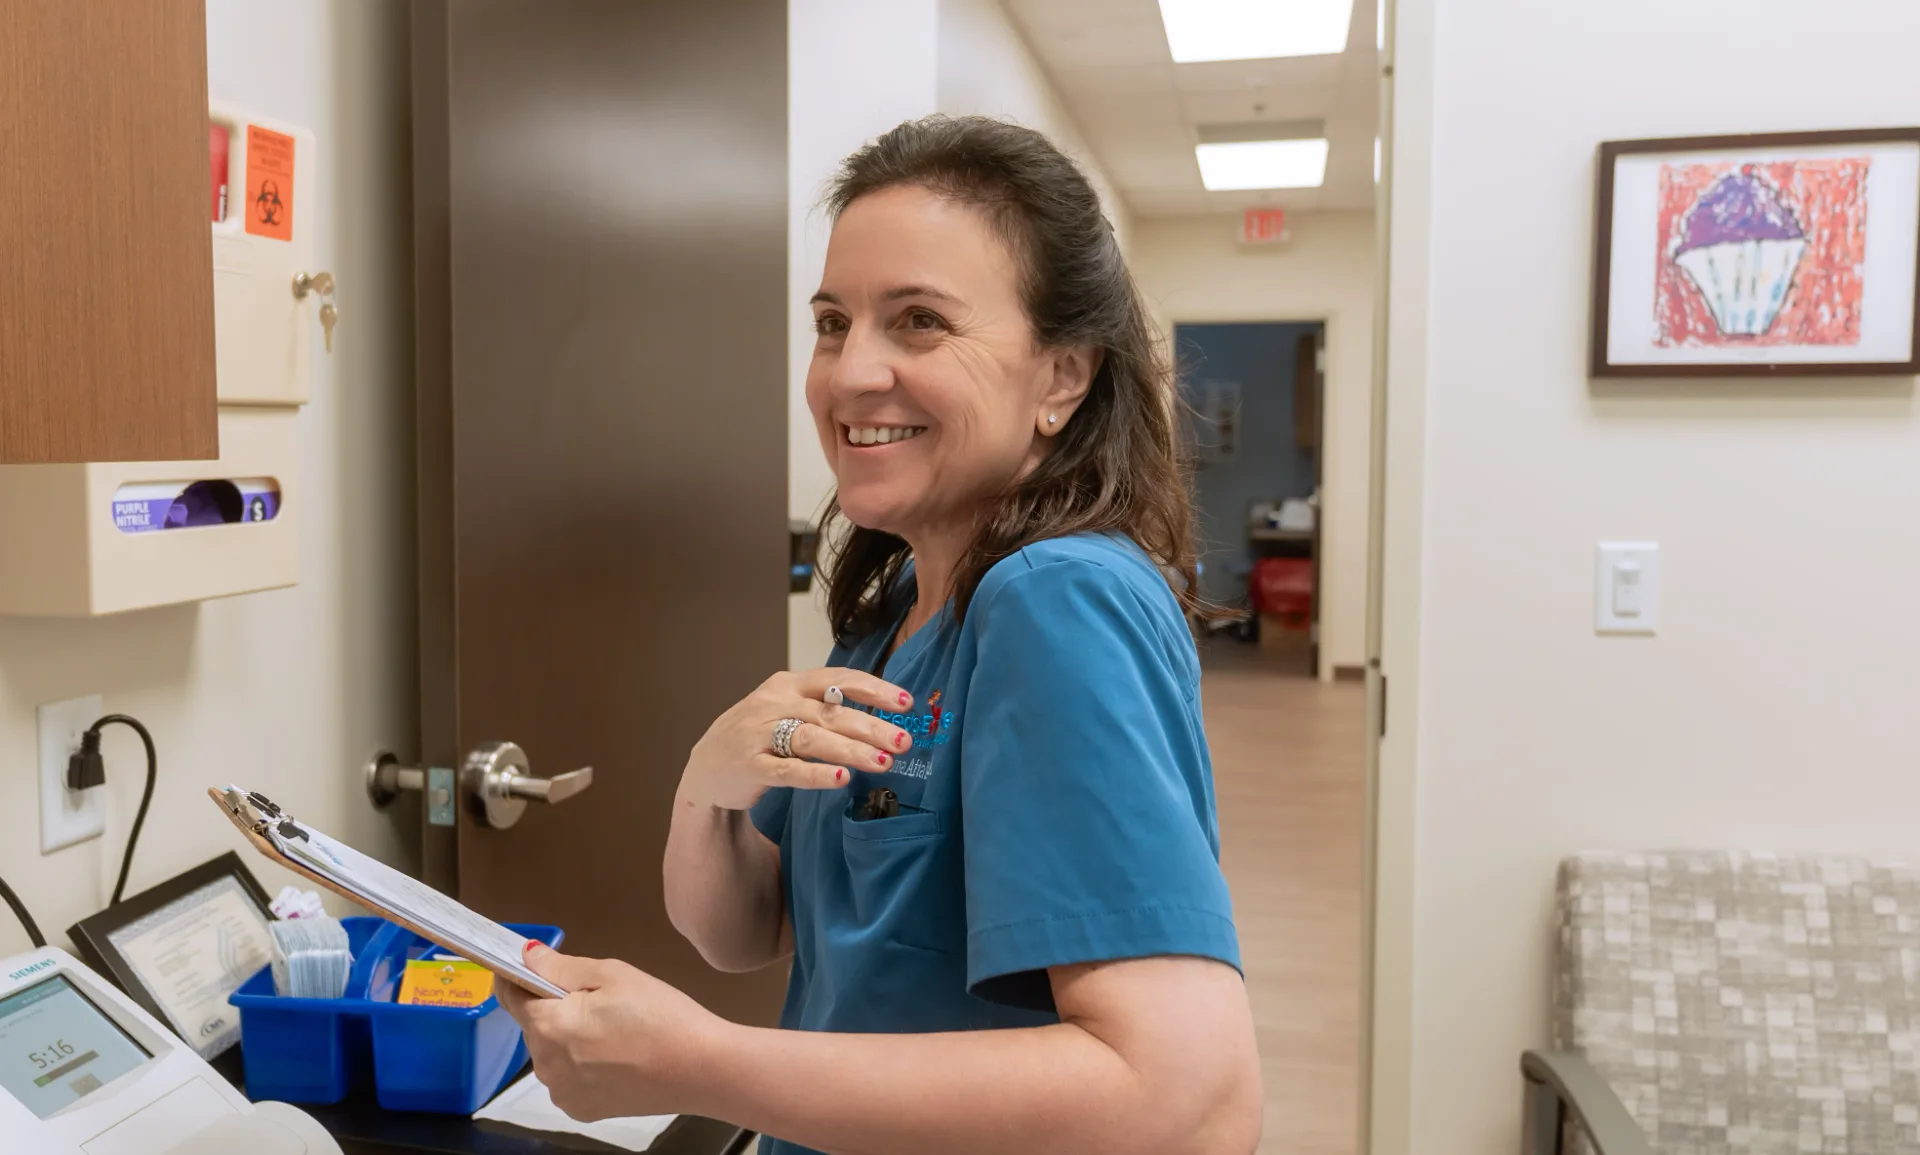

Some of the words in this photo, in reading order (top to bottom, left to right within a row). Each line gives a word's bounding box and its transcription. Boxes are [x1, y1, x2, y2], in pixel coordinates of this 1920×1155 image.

[115, 502, 149, 514] PURPLE
[253, 501, 264, 522] S
[116, 515, 150, 527] NITRILE
[9, 959, 57, 980] SIEMENS
[414, 986, 444, 997] Neon
[28, 1039, 75, 1069] 5:16
